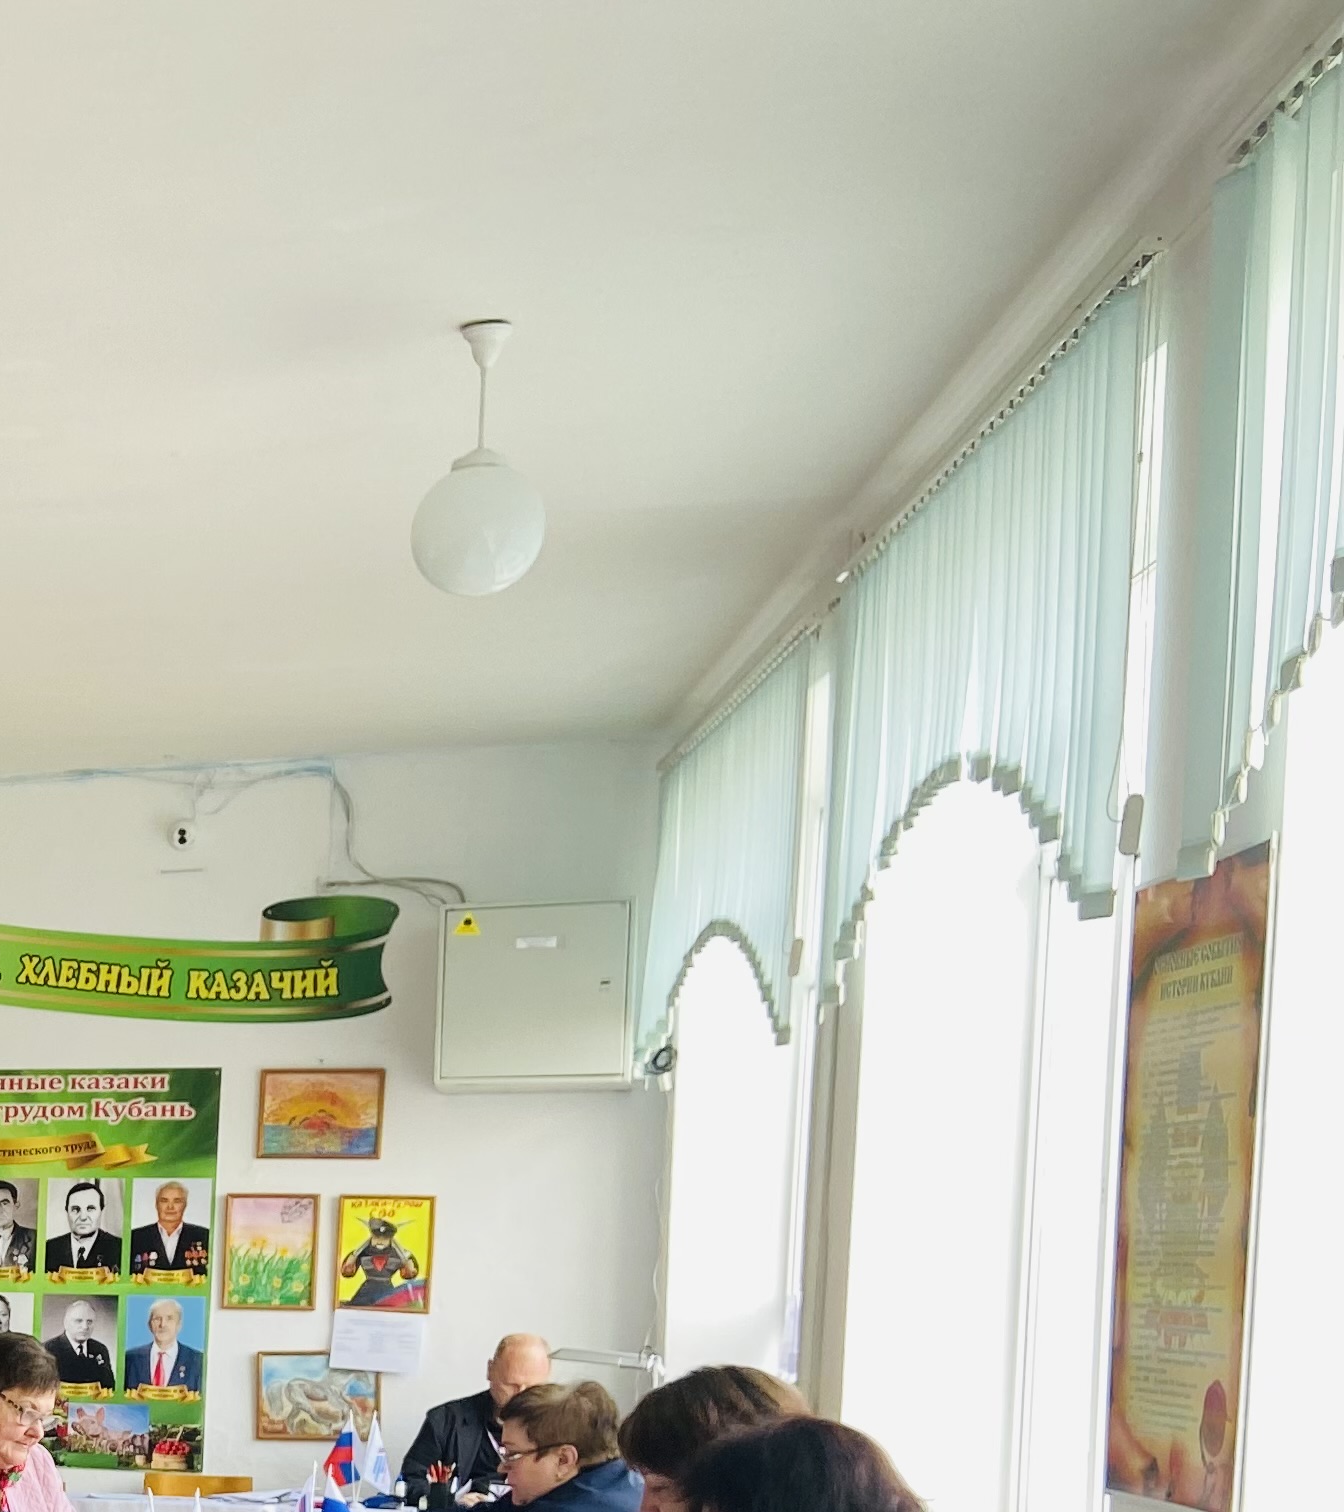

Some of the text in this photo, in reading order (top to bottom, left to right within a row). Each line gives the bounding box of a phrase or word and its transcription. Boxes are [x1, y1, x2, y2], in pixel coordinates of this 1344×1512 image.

[16, 954, 173, 998] ХЛЕБНЫЙ
[185, 959, 340, 1001] КАЗАЧИЙ
[70, 1075, 166, 1091] казаки
[93, 1099, 194, 1122] Кубань
[63, 1139, 97, 1156] труда
